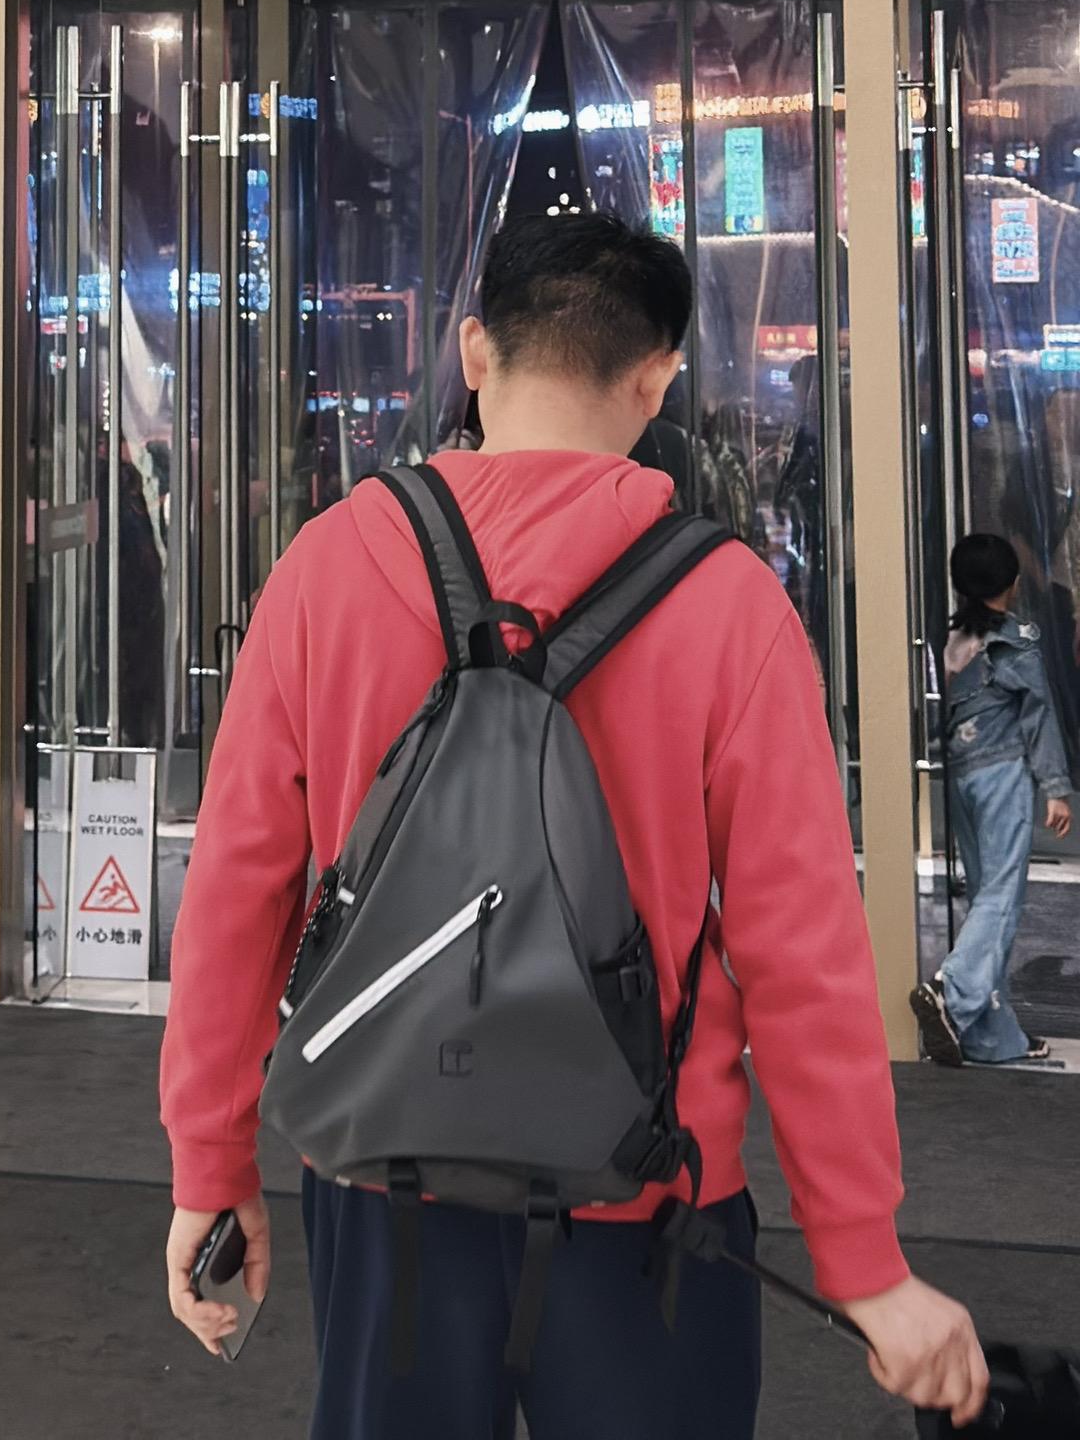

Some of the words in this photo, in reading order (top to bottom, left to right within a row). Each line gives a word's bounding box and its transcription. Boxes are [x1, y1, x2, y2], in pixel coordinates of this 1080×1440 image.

[88, 813, 138, 825] CAUTION
[81, 825, 104, 835] WET
[106, 826, 144, 836] FLOOR
[76, 926, 143, 945] 小心地滑
